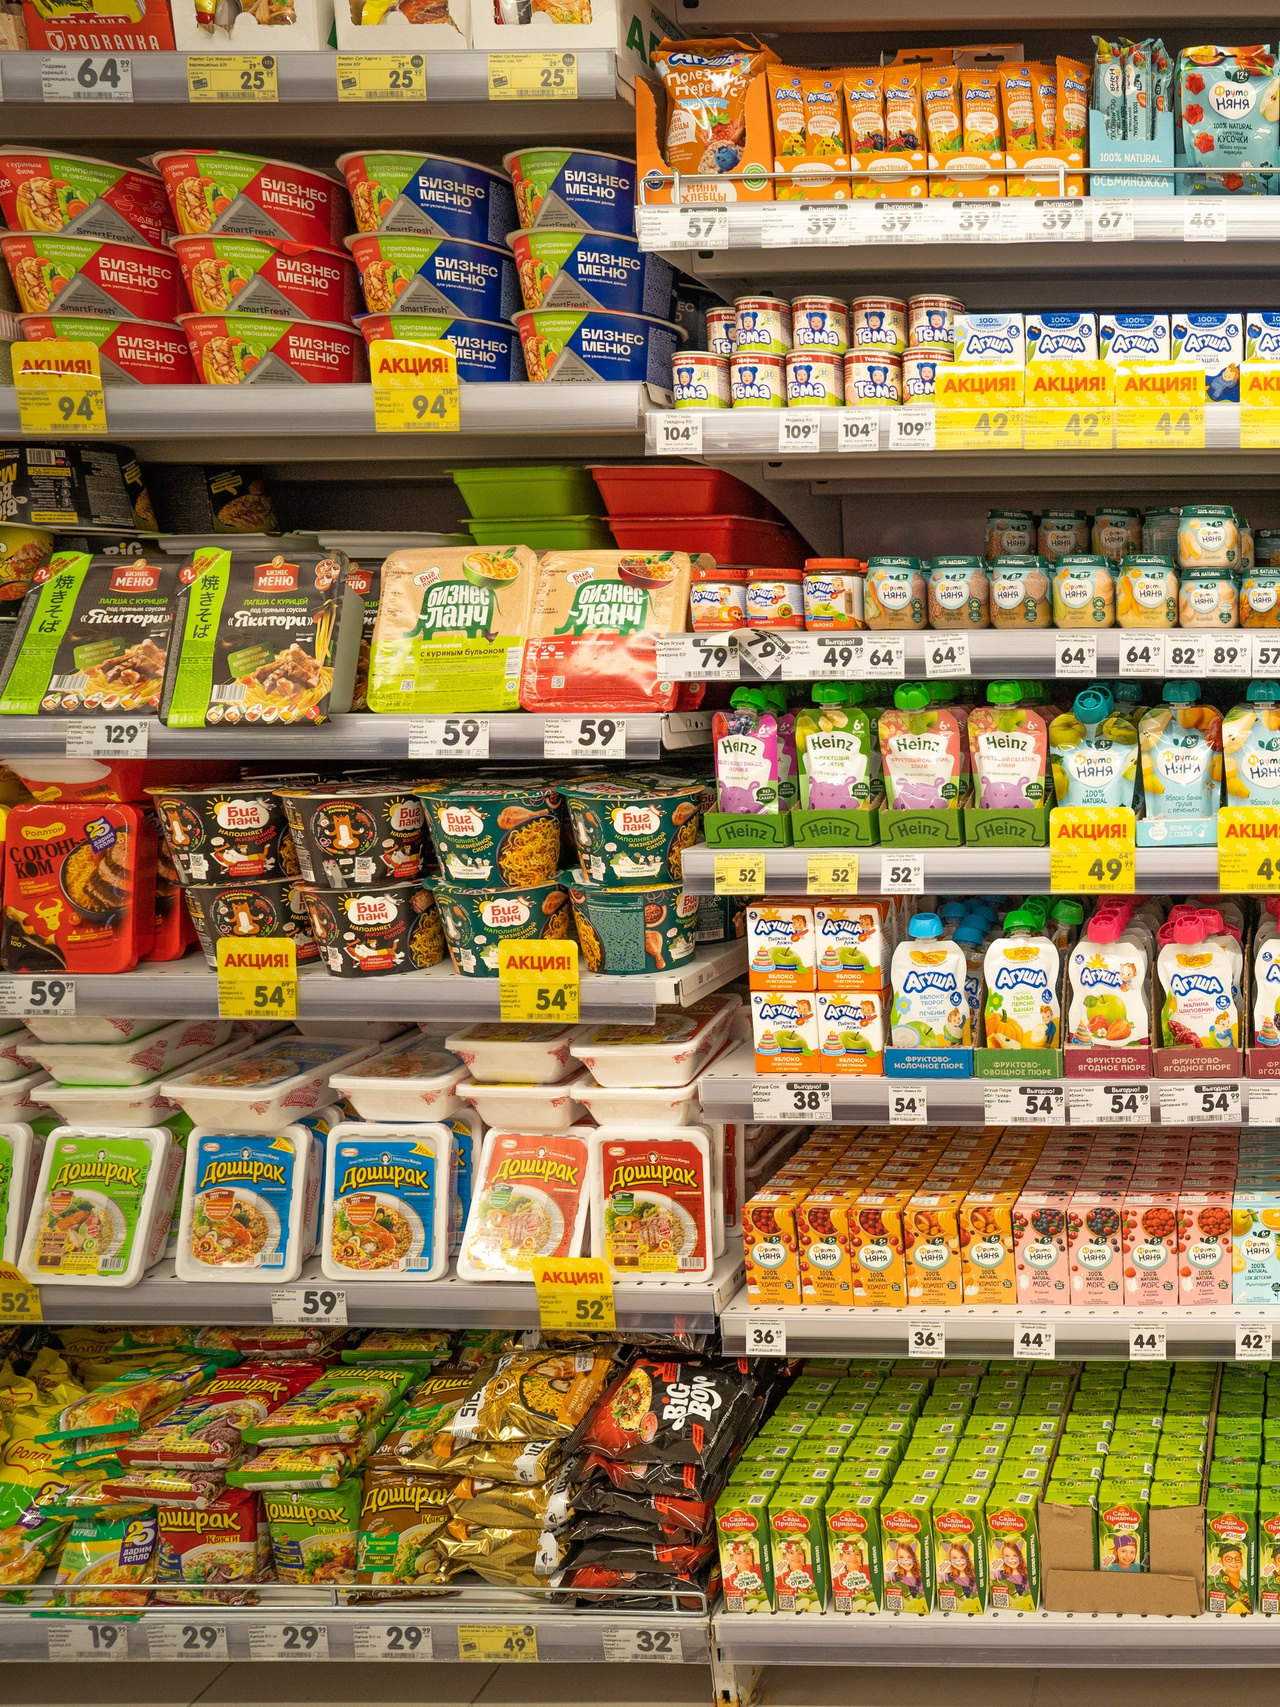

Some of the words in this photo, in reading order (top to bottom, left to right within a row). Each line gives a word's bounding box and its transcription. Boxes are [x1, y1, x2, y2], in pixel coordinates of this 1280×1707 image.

[68, 33, 160, 50] PODRAVKA
[77, 58, 122, 88] 64
[241, 72, 264, 89] 25
[389, 70, 413, 88] 25
[1099, 153, 1123, 163] 100%
[1125, 153, 1162, 164] NATURAL
[418, 177, 486, 200] БИЗНЕС
[419, 191, 472, 207] МЕНЮ
[687, 218, 716, 238] 57
[576, 250, 641, 271] БИЗНЕС
[577, 265, 629, 280] МЕНЮ
[379, 357, 449, 375] АКЦИЯ!
[1033, 376, 1107, 394] АКЦИЯ!
[58, 397, 93, 421] 94
[413, 395, 447, 419] 94
[664, 427, 690, 440] 104
[898, 422, 924, 435] 109
[1065, 414, 1099, 436] 42
[258, 576, 294, 587] МЕНЮ
[428, 584, 490, 607] бизнес
[426, 605, 488, 627] ланч
[427, 647, 463, 658] куриным
[466, 646, 504, 657] бульоном
[699, 648, 728, 668] 79
[824, 648, 852, 667] 49
[870, 650, 893, 666] 64
[1172, 648, 1195, 664] 82
[105, 725, 138, 743] 129
[442, 719, 480, 746] 59
[985, 735, 1028, 753] Heinz
[725, 823, 767, 840] Heinz
[1057, 822, 1127, 840] АКЦИЯ!
[890, 867, 911, 882] 52
[1088, 859, 1122, 881] 49
[224, 951, 290, 970] АКЦИЯ!
[536, 989, 567, 1010] 54
[893, 1061, 938, 1070] МОЛОЧНОЕ
[940, 1061, 964, 1069] ПЮРЕ
[1027, 1068, 1053, 1076] ПЮРЕ
[793, 1091, 820, 1110] 38
[339, 1162, 429, 1190] Доширак
[303, 1291, 336, 1314] 59
[576, 1300, 604, 1320] 52
[754, 1329, 774, 1344] 36
[90, 1625, 118, 1648] 19
[504, 1638, 525, 1652] 49
[638, 1630, 672, 1651] 32
